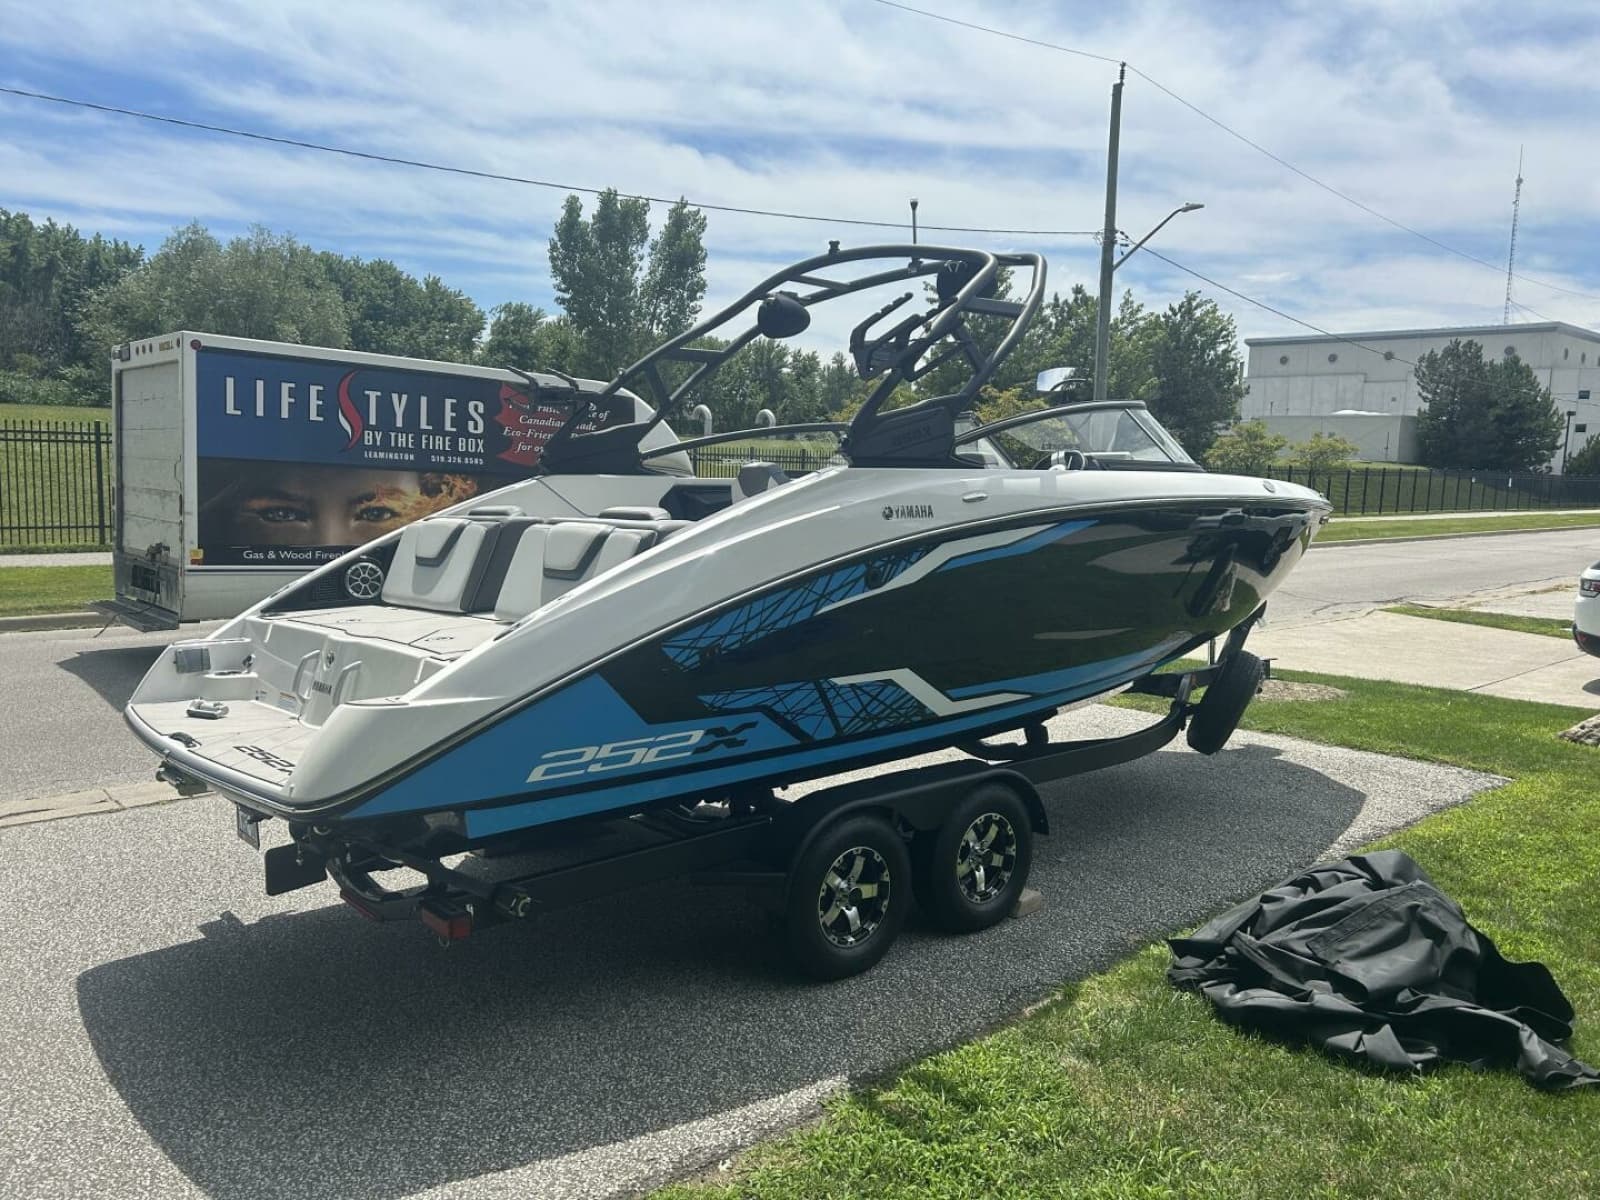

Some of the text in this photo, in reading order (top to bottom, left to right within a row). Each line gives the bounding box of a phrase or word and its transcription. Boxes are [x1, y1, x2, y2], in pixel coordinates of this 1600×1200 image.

[364, 430, 485, 454] BY THE FIRE BOX
[513, 441, 532, 453] for
[364, 450, 414, 461] LEAMINGTON
[892, 504, 934, 519] YAMAHA
[243, 550, 264, 559] Gas
[267, 550, 276, 559] &
[279, 550, 312, 559] Wood
[526, 721, 758, 783] 252X
